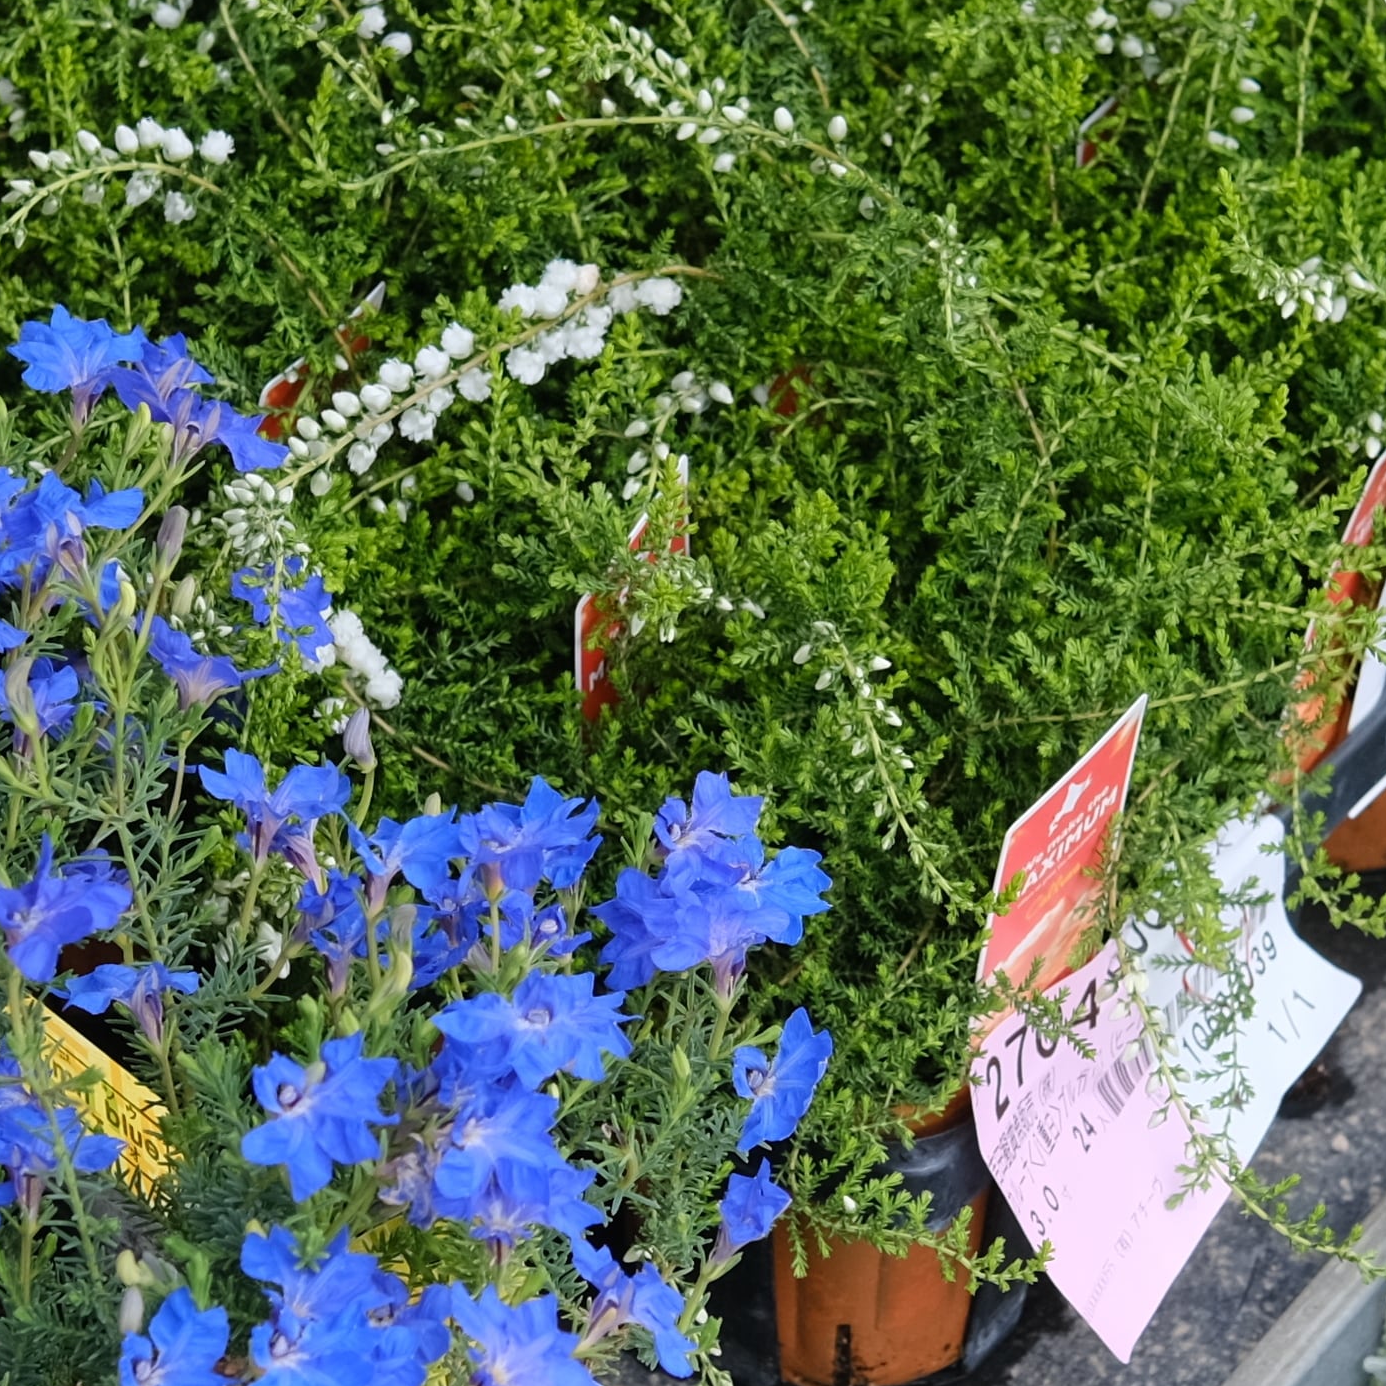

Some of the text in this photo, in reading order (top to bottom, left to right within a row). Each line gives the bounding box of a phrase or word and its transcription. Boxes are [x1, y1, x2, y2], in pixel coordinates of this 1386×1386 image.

[1016, 783, 1119, 898] AXIMUM
[1046, 812, 1085, 854] make
[1267, 989, 1316, 1045] 1/1
[104, 1099, 159, 1161] blue
[1072, 1112, 1097, 1153] 24
[1030, 1184, 1060, 1237] 3.0
